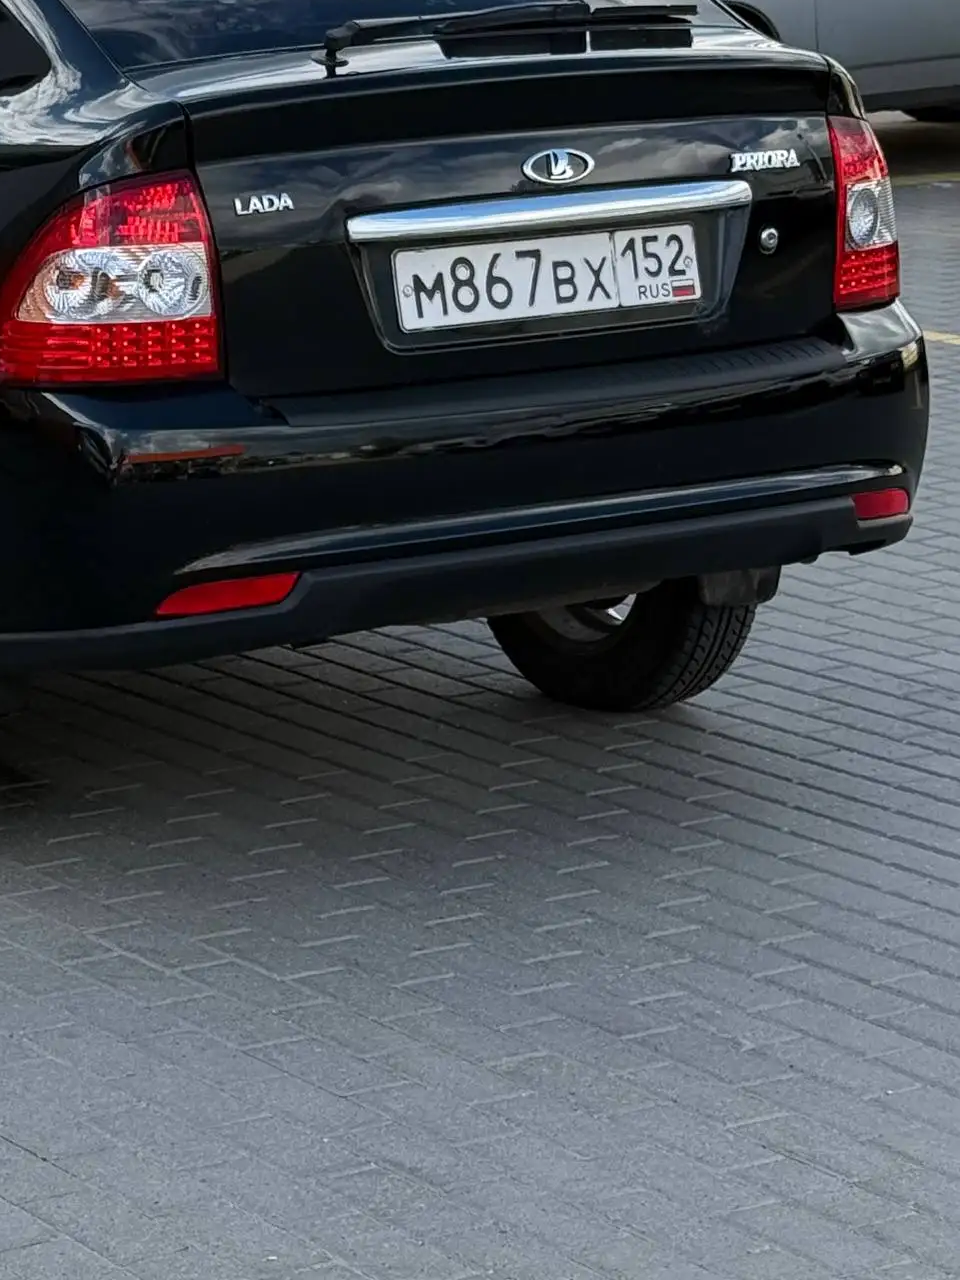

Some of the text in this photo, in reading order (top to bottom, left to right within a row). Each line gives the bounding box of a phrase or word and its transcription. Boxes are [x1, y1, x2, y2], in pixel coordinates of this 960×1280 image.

[731, 148, 801, 173] PRIORA
[233, 192, 295, 216] LADA
[621, 234, 687, 280] 152
[639, 284, 670, 300] RUS
